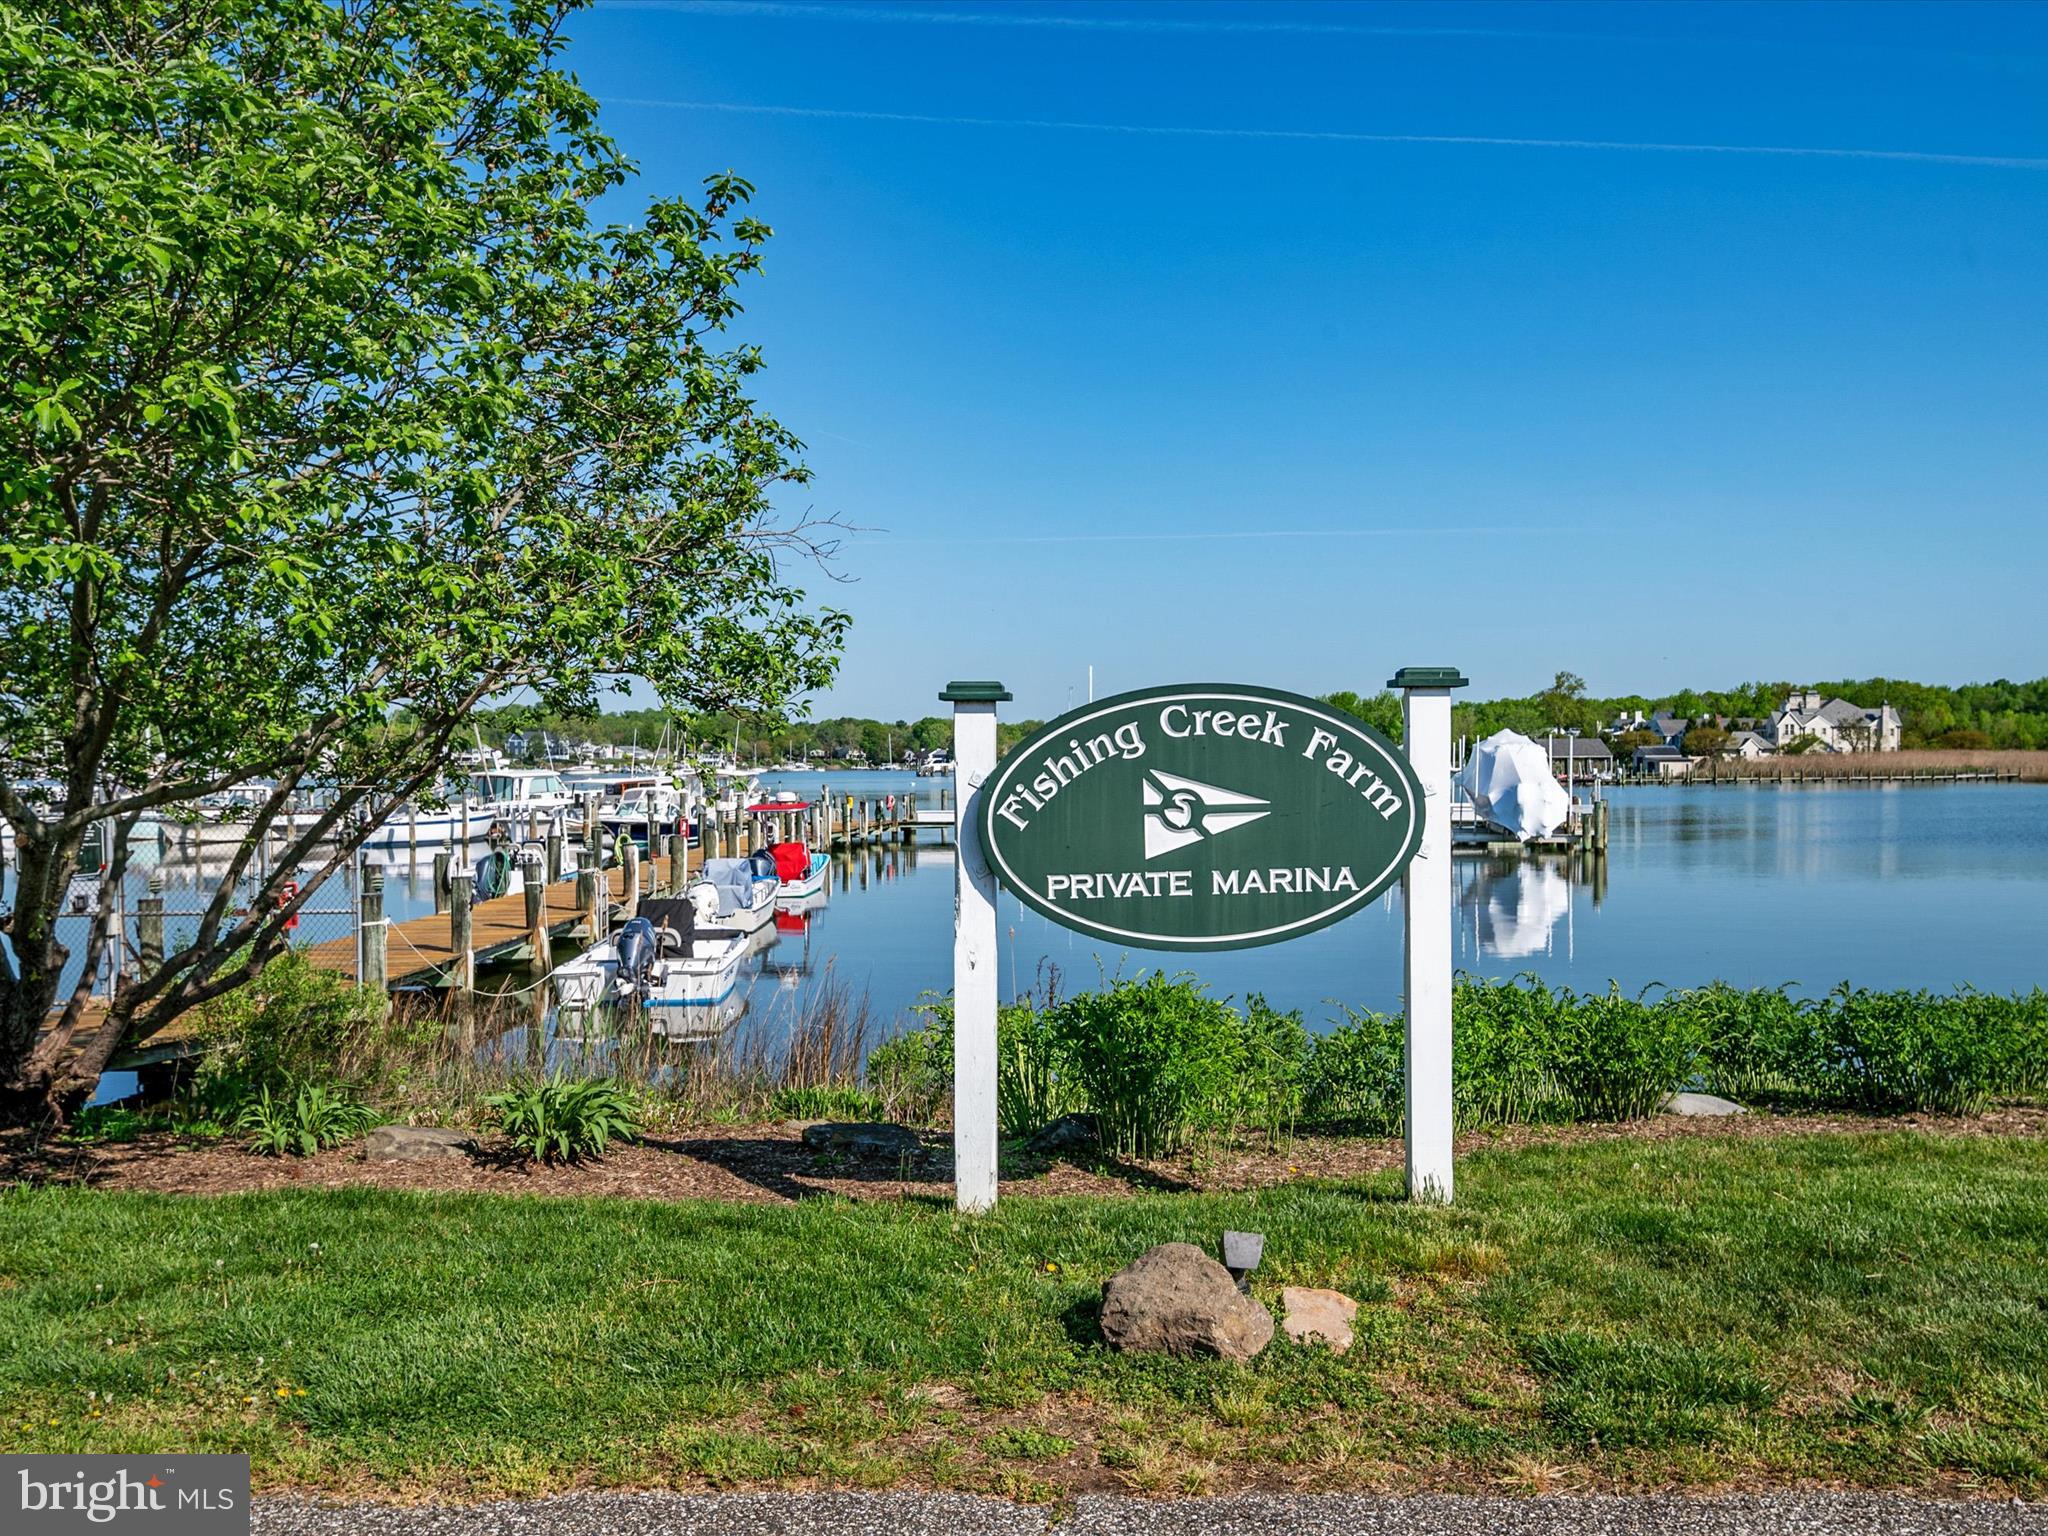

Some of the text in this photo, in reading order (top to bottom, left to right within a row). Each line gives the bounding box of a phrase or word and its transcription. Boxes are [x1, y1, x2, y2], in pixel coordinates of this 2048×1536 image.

[996, 704, 1403, 832] Fishing Creek Farm
[1046, 866, 1361, 900] PRIVATE MARINA
